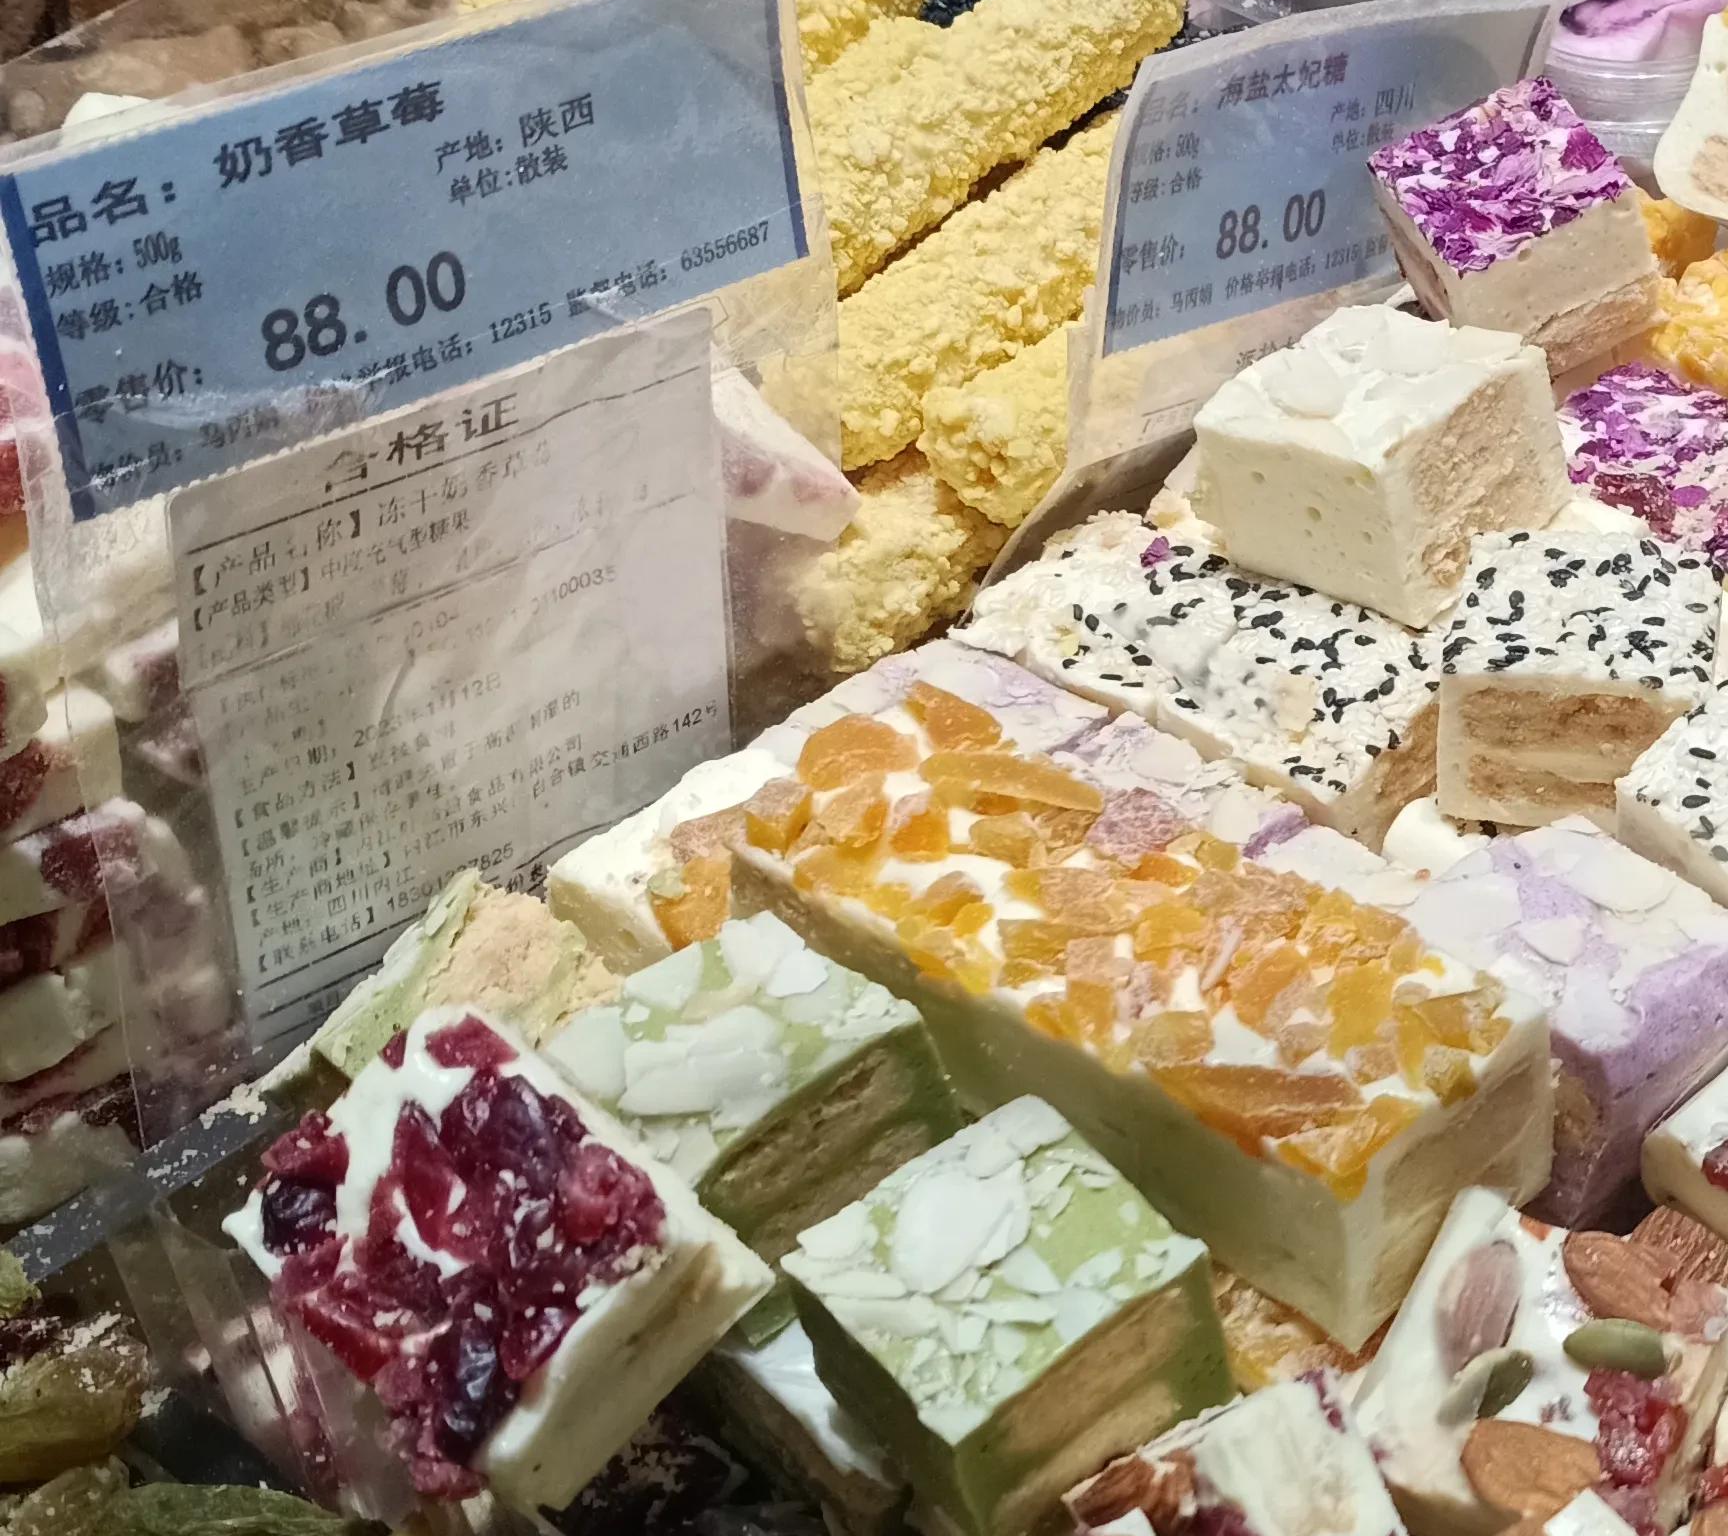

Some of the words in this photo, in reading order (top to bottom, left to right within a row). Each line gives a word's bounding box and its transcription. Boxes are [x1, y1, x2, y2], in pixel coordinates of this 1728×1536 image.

[1216, 190, 1326, 260] 88.00
[262, 251, 466, 372] 88.00
[324, 393, 518, 492] 合格证
